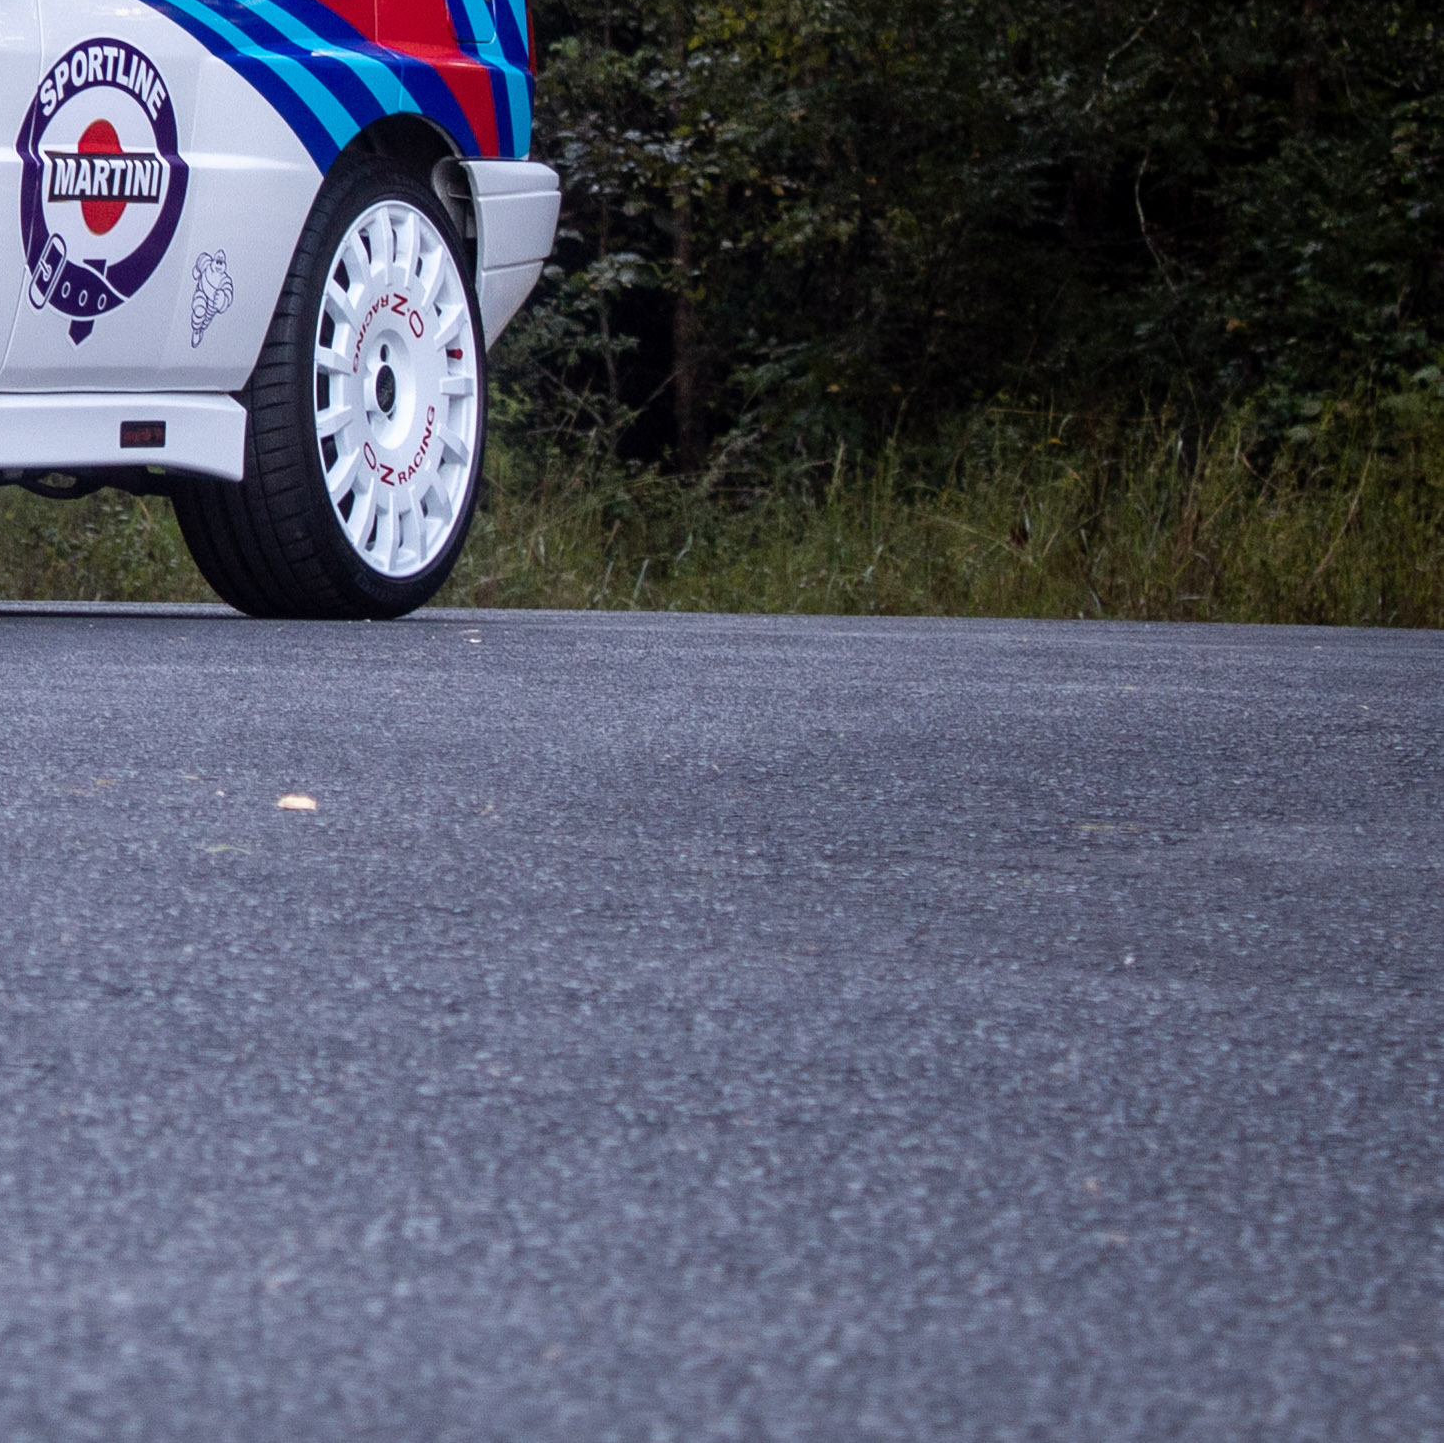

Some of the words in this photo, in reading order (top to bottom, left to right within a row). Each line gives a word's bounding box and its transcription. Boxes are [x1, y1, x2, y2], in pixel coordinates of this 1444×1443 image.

[39, 45, 166, 122] SPORTLINE
[53, 158, 161, 197] MARTINI
[397, 404, 436, 485] RACING
